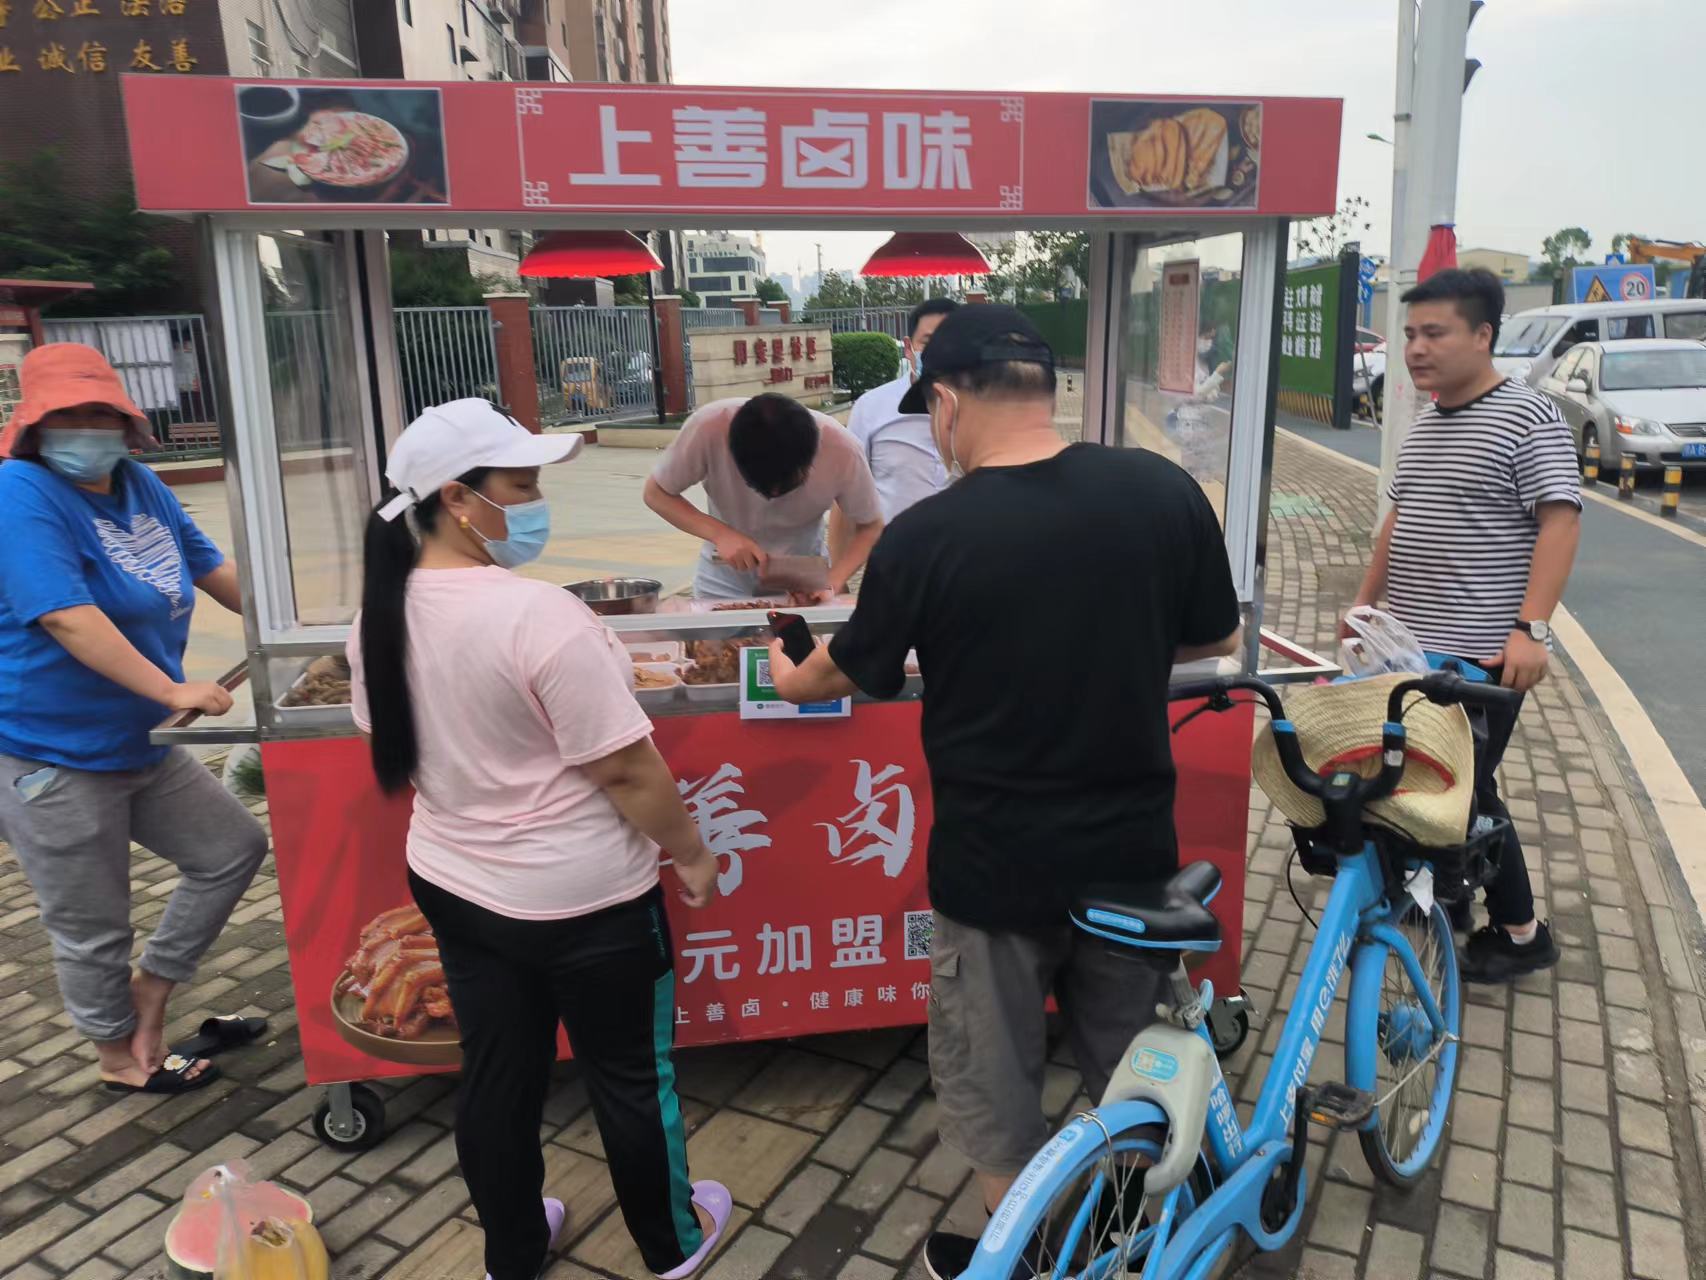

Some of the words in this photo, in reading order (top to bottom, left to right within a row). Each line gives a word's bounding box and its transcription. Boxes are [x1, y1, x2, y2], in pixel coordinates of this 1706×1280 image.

[38, 41, 109, 73] 诚信
[129, 38, 198, 72] 友善
[569, 105, 972, 190] 上善卤味
[1626, 281, 1645, 297] 20
[681, 914, 887, 984] 元加盟
